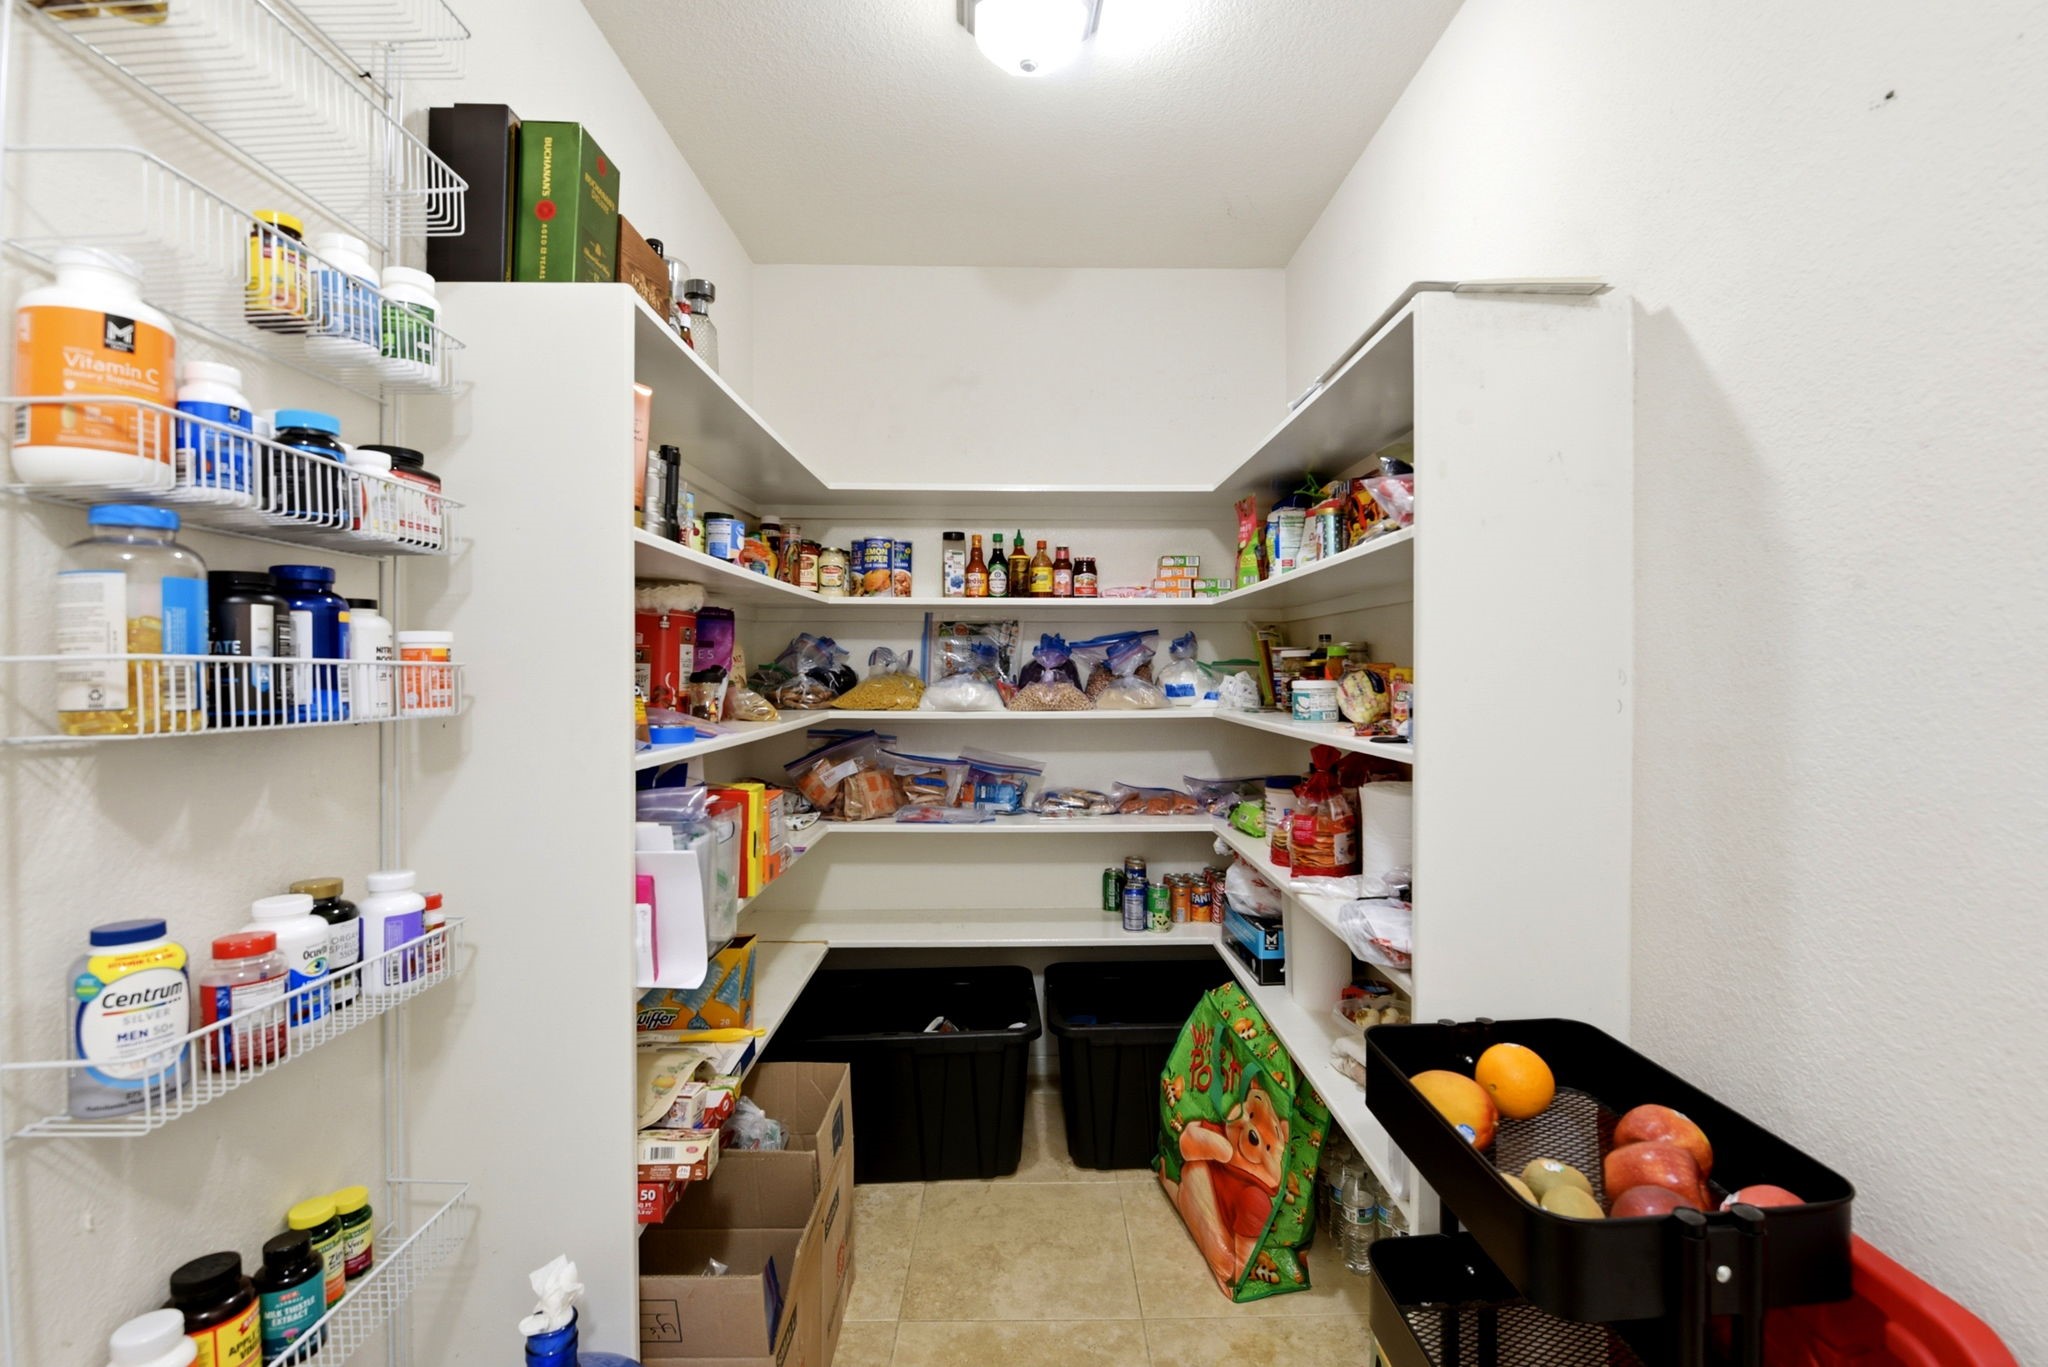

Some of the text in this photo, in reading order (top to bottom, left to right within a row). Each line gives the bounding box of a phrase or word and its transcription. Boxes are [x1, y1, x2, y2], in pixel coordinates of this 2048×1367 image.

[542, 137, 553, 197] BUCHANAN'S
[62, 351, 159, 385] Vitamin C
[1191, 892, 1211, 904] FANT
[102, 981, 182, 1009] Centrum
[123, 1008, 171, 1026] SILVER
[720, 1018, 731, 1026] 20
[117, 1022, 174, 1042] MEN 50+
[641, 1189, 656, 1200] 50
[264, 1309, 282, 1319] MILK
[284, 1295, 315, 1317] THISTLE
[271, 1308, 309, 1327] EXTRACT
